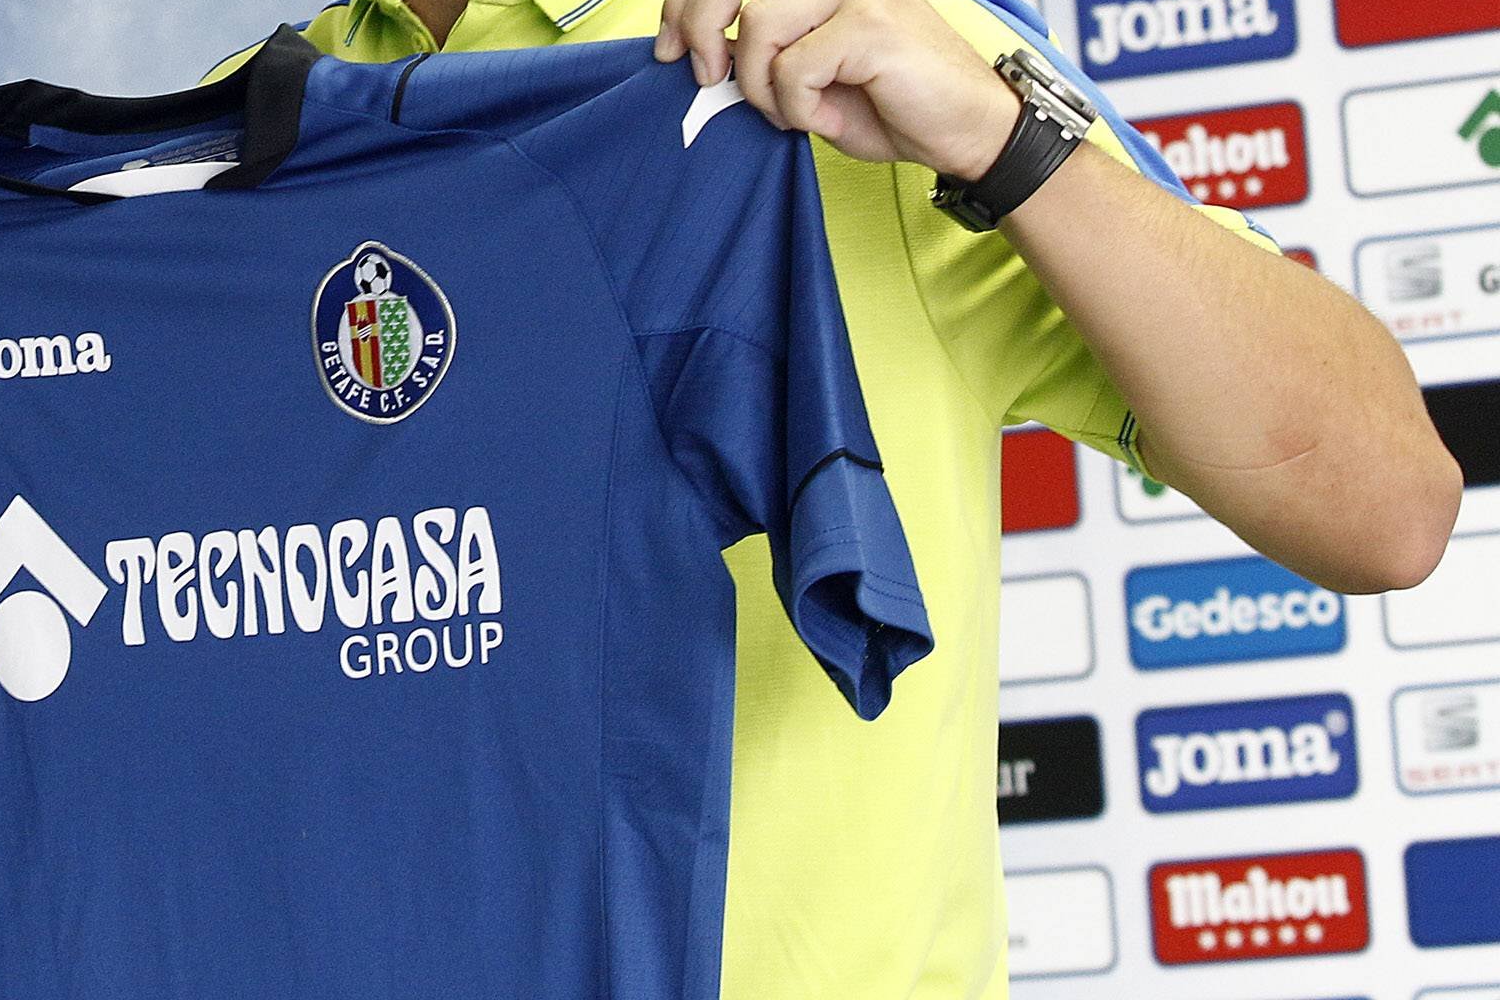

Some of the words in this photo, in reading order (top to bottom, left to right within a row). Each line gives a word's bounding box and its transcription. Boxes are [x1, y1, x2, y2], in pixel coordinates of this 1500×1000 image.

[1148, 122, 1290, 182] ahou
[321, 341, 372, 410] GETAFE
[379, 387, 412, 413] C.F.
[411, 329, 445, 389] S.A.D.
[105, 505, 503, 646] TECNOCASA
[1131, 588, 1342, 641] Gedesco
[339, 621, 504, 679] GROUP
[1165, 865, 1352, 928] Mahou
